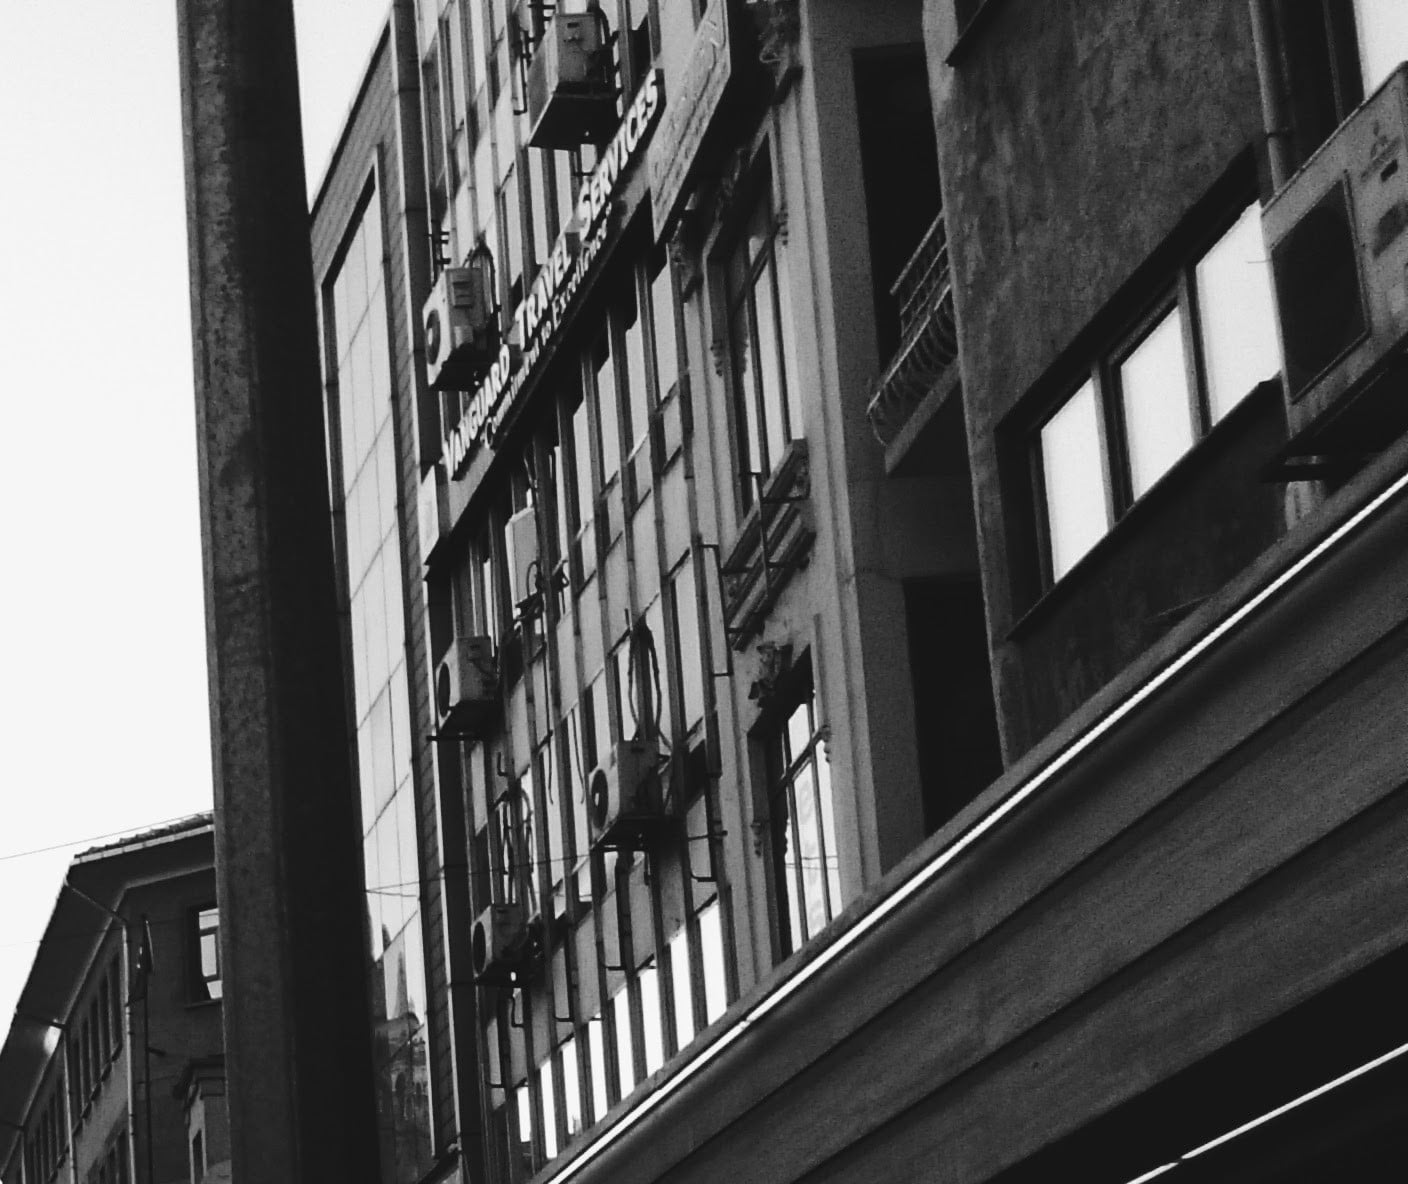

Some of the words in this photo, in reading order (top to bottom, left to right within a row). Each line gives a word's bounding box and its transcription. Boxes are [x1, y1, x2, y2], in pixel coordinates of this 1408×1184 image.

[441, 343, 511, 472] VANGUARD
[514, 233, 573, 353] TRAVEL
[575, 68, 663, 244] SERVICES
